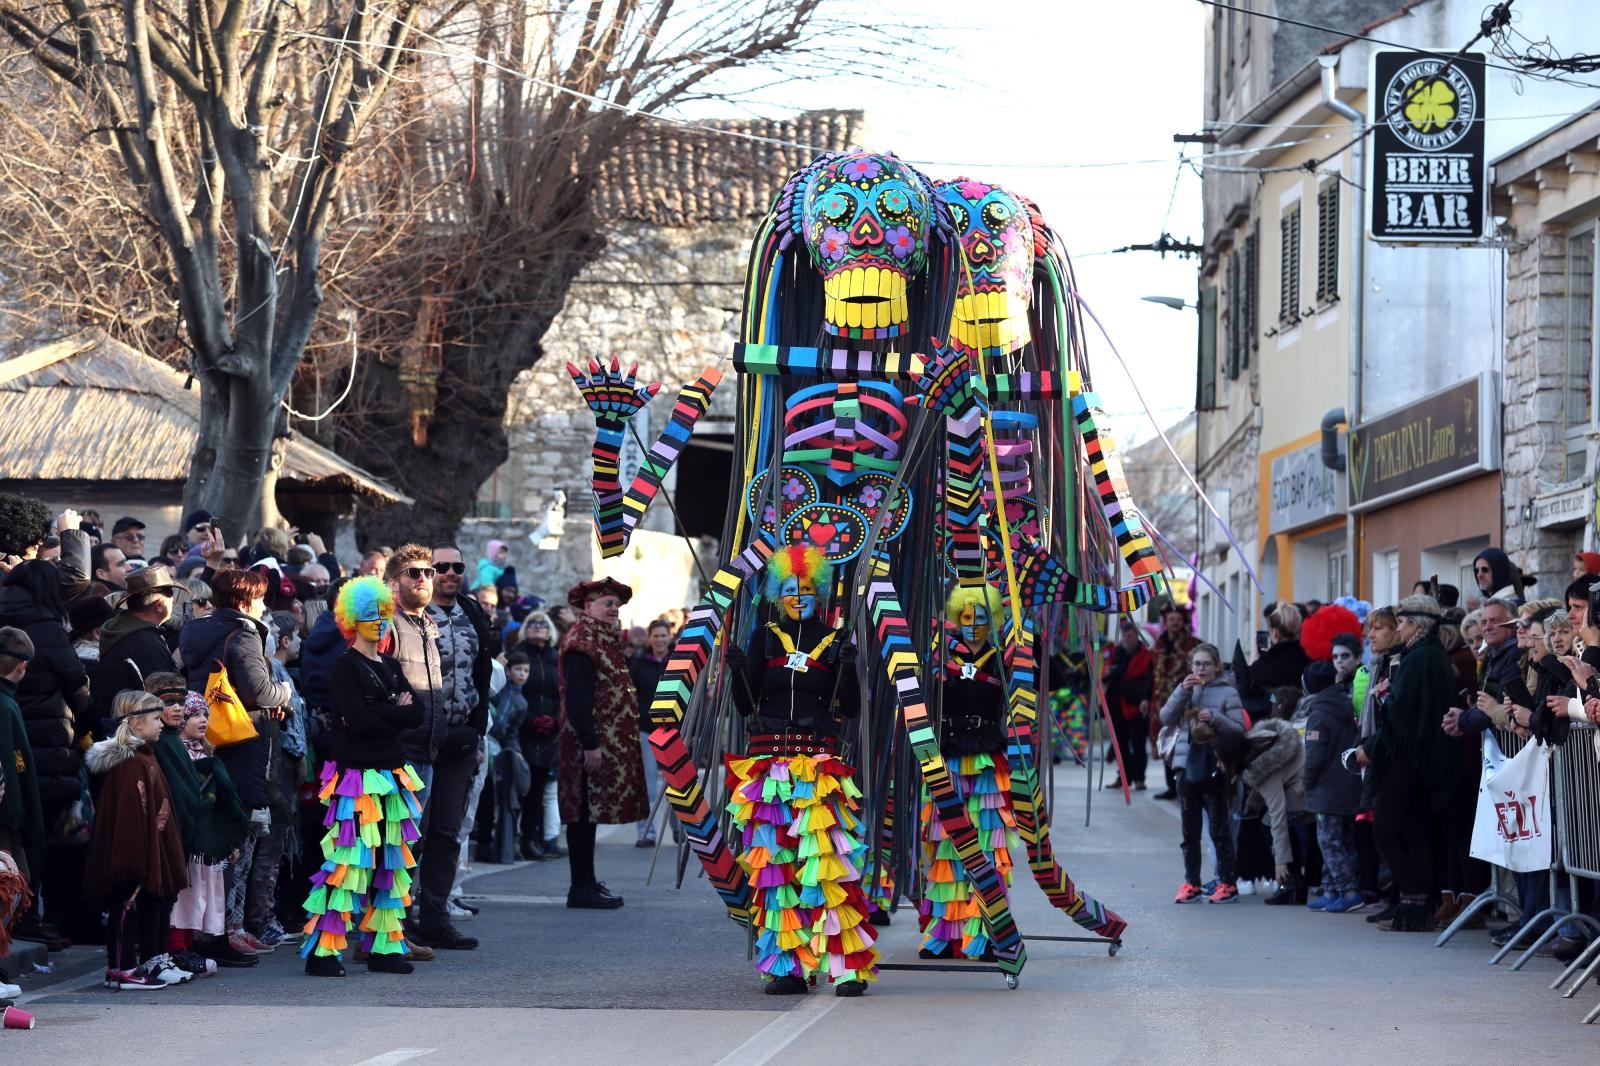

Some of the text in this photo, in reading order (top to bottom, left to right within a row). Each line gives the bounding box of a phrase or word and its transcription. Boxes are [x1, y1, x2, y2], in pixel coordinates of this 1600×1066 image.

[1399, 62, 1439, 85] HOUSE
[1404, 128, 1457, 148] MURTER
[1386, 157, 1472, 184] BEER
[1386, 193, 1472, 227] BAR
[1373, 420, 1425, 483] PEKARNA
[1494, 790, 1542, 843] EŽI
